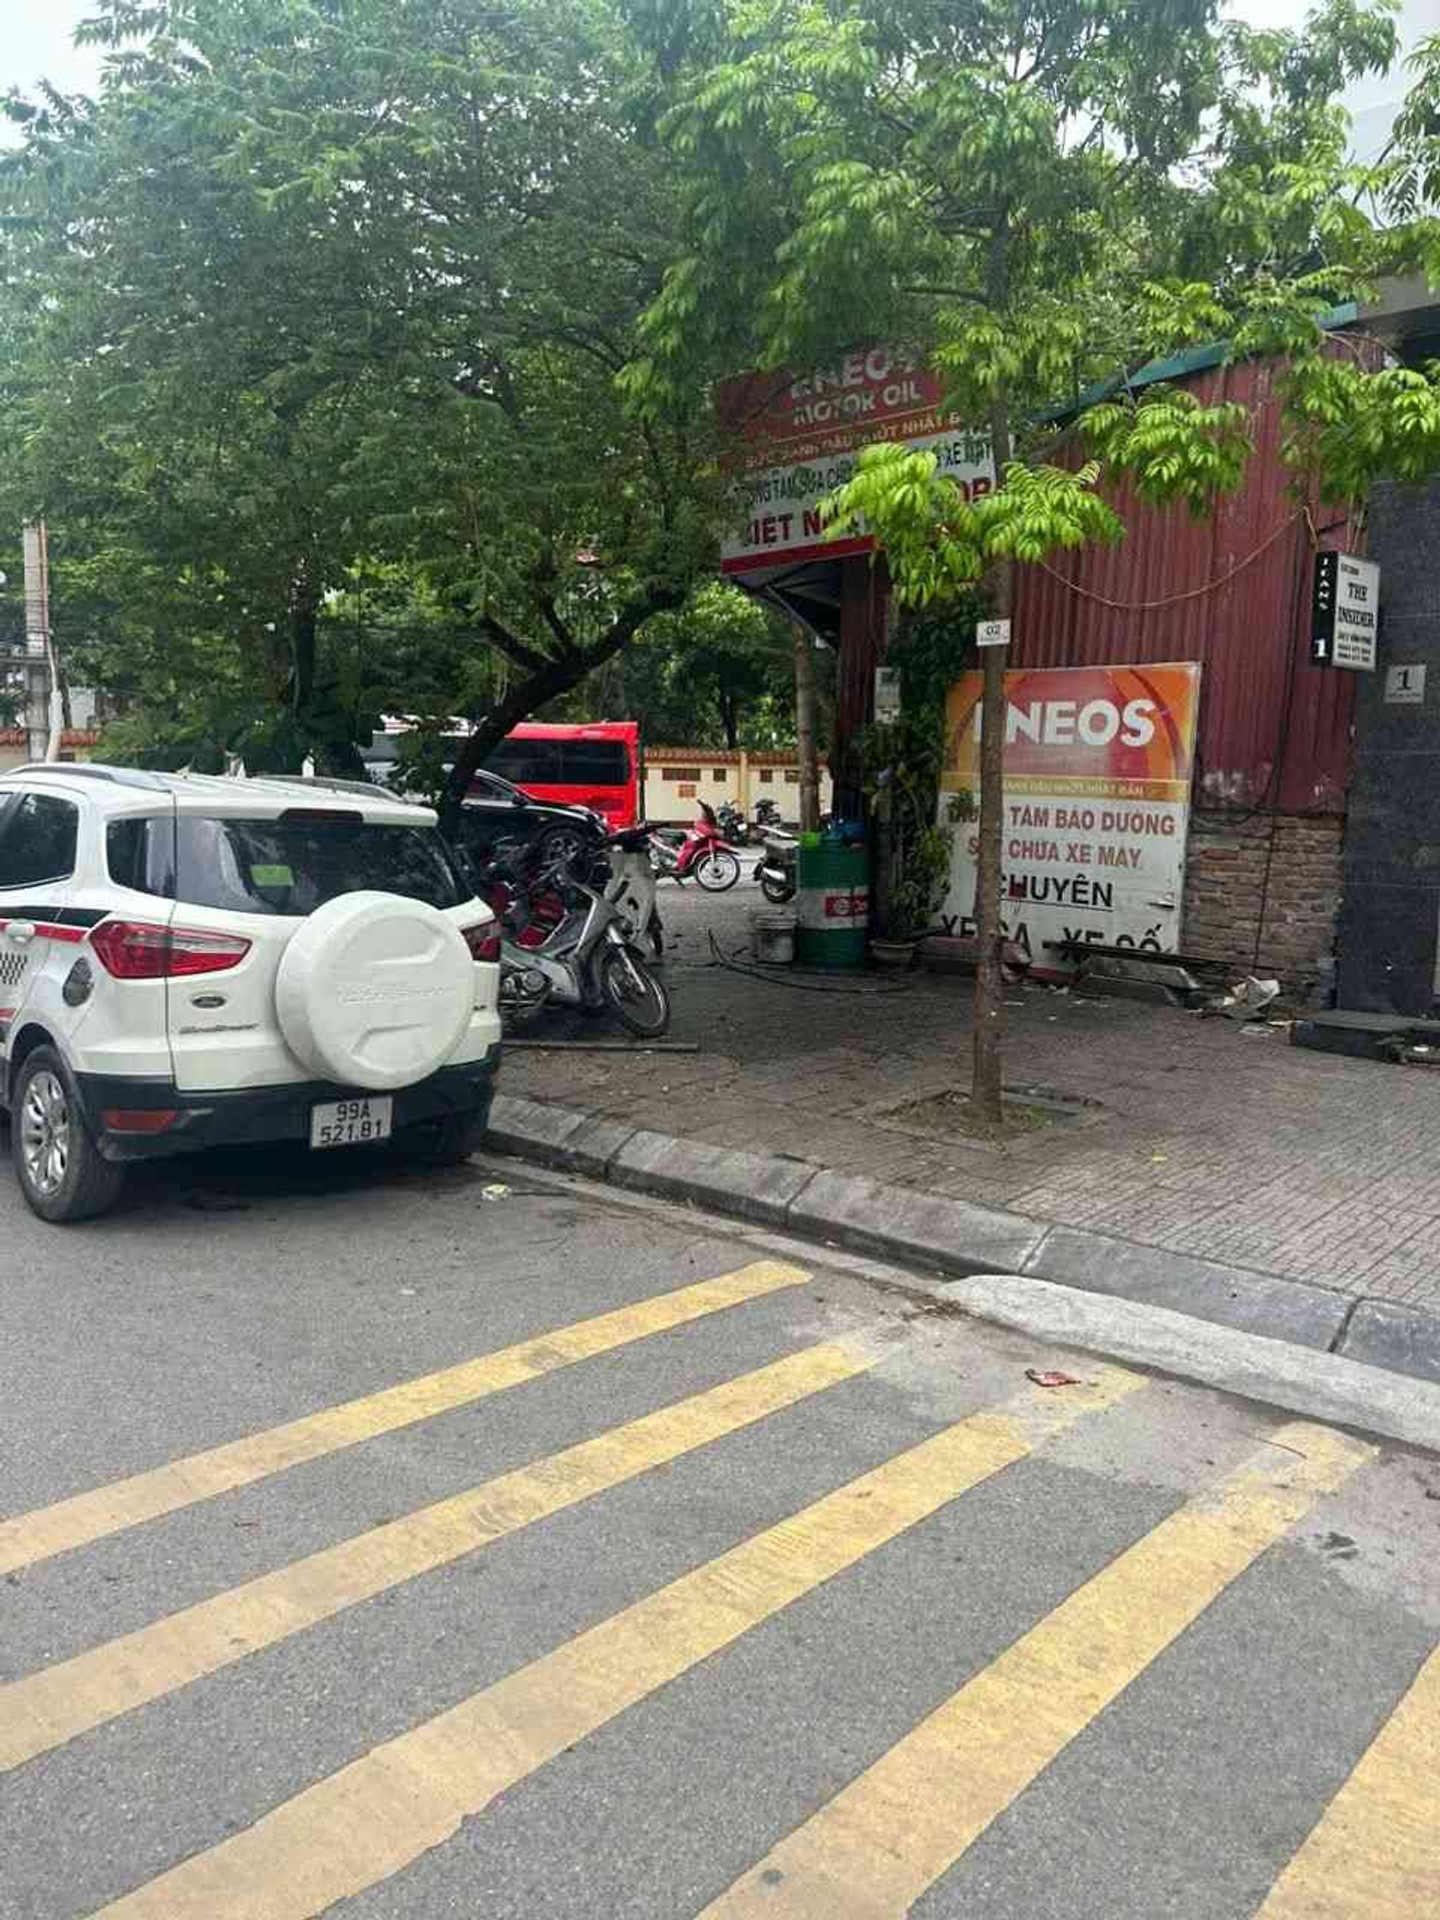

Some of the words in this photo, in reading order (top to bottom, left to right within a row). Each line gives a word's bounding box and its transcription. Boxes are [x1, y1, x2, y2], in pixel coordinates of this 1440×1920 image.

[883, 380, 921, 406] OIL
[1348, 582, 1368, 602] THE
[1397, 669, 1412, 691] 1
[974, 699, 1156, 747] NEOS
[1065, 842, 1092, 866] XE
[335, 1101, 371, 1122] 99A
[319, 1119, 383, 1144] 521.81
